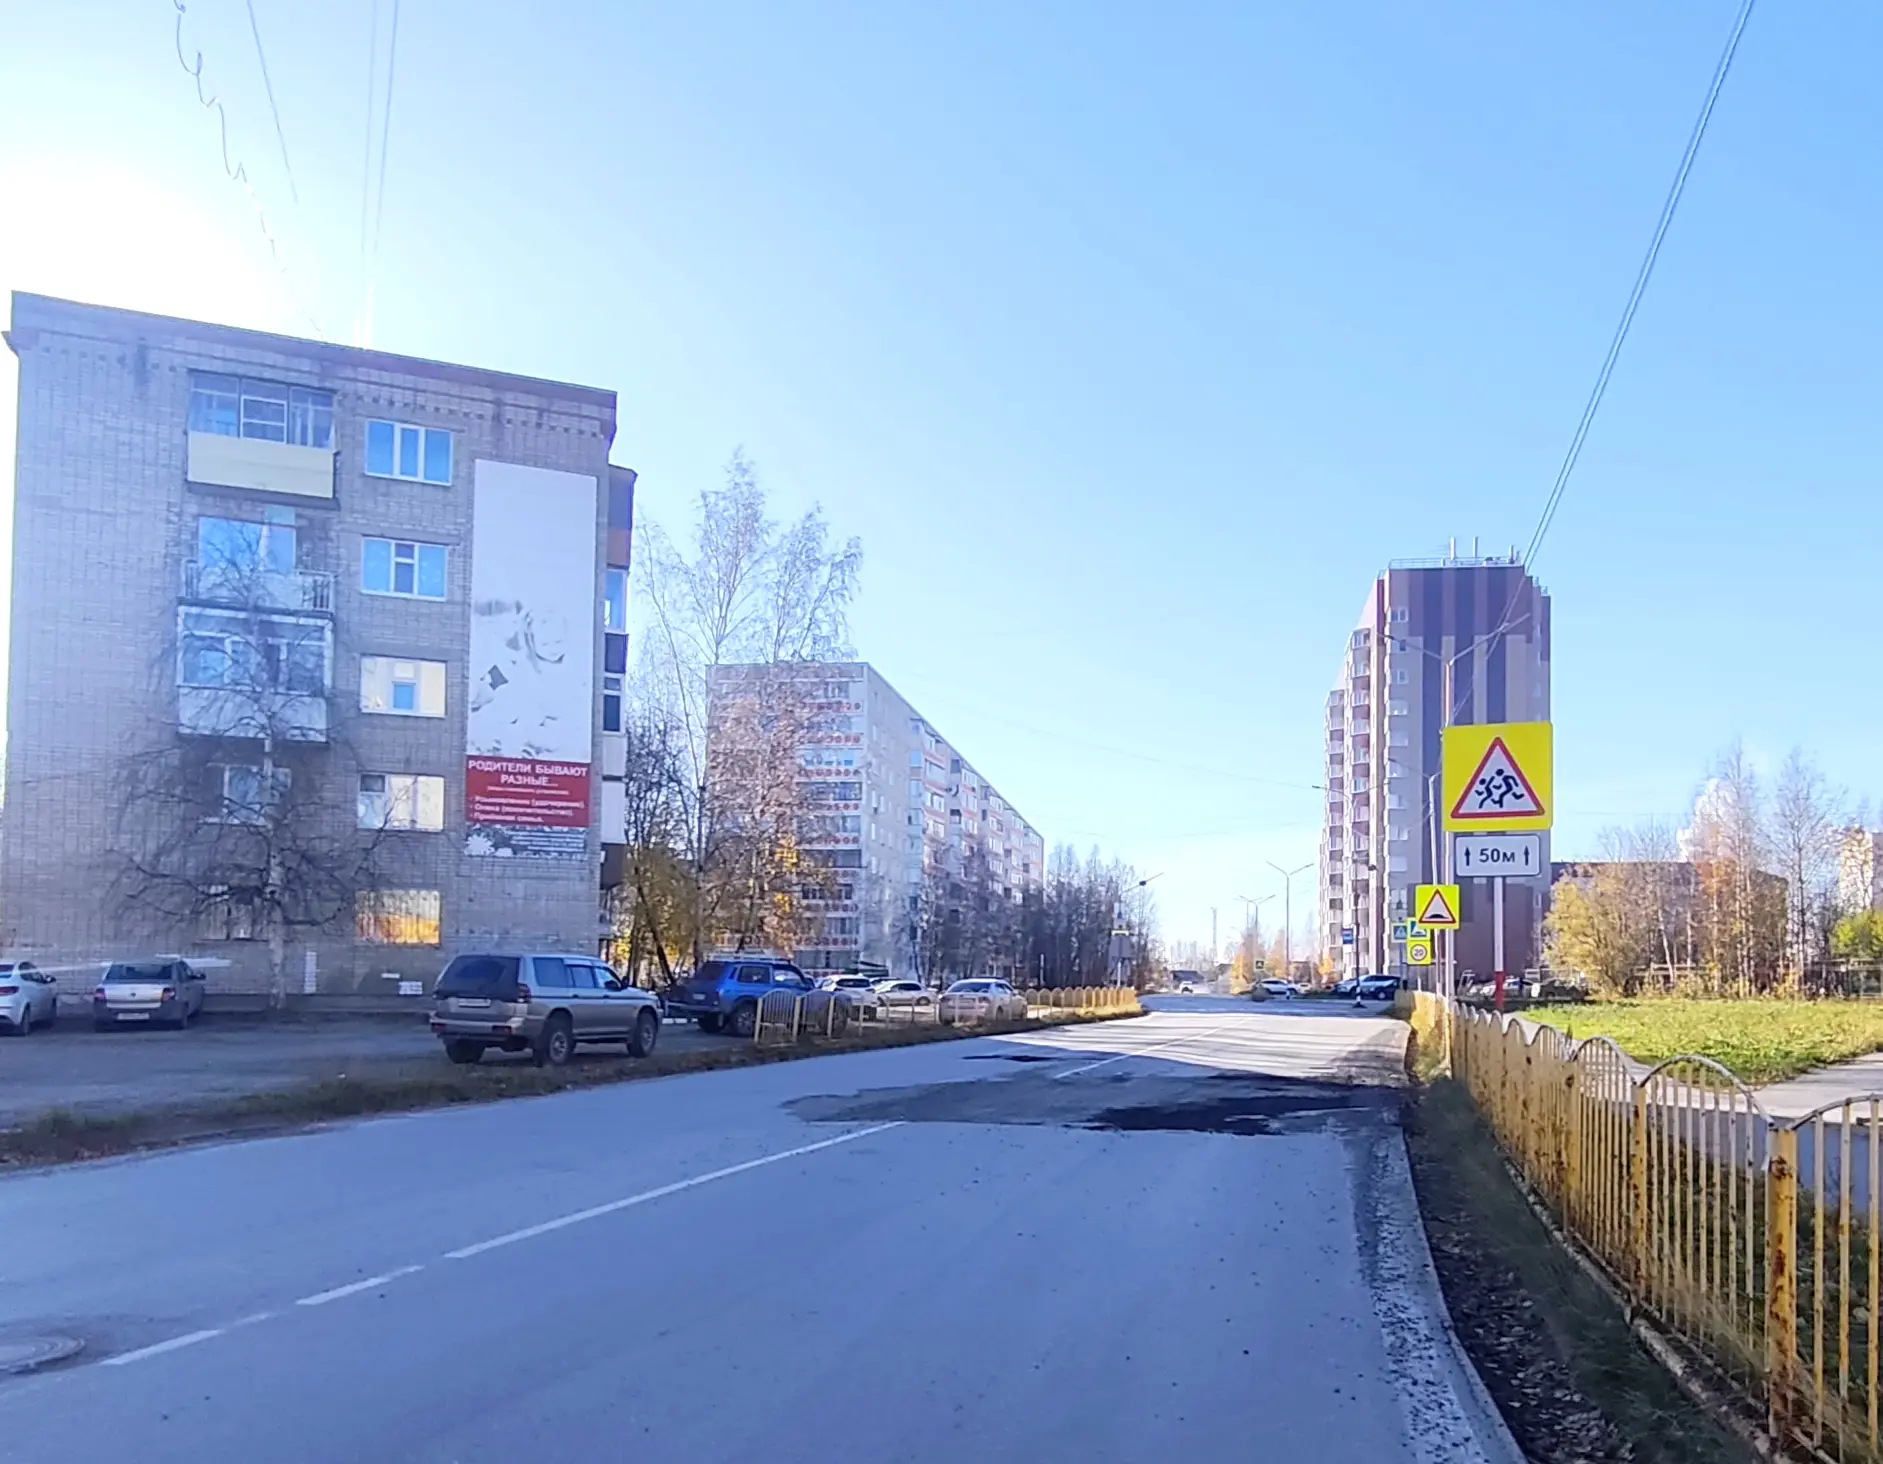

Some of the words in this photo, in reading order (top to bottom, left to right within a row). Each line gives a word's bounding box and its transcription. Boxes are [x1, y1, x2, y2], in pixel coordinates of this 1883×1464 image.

[468, 760, 531, 772] РОДИТЕЛИ
[536, 765, 587, 777] БЫВАЮТ
[1414, 948, 1424, 956] 20
